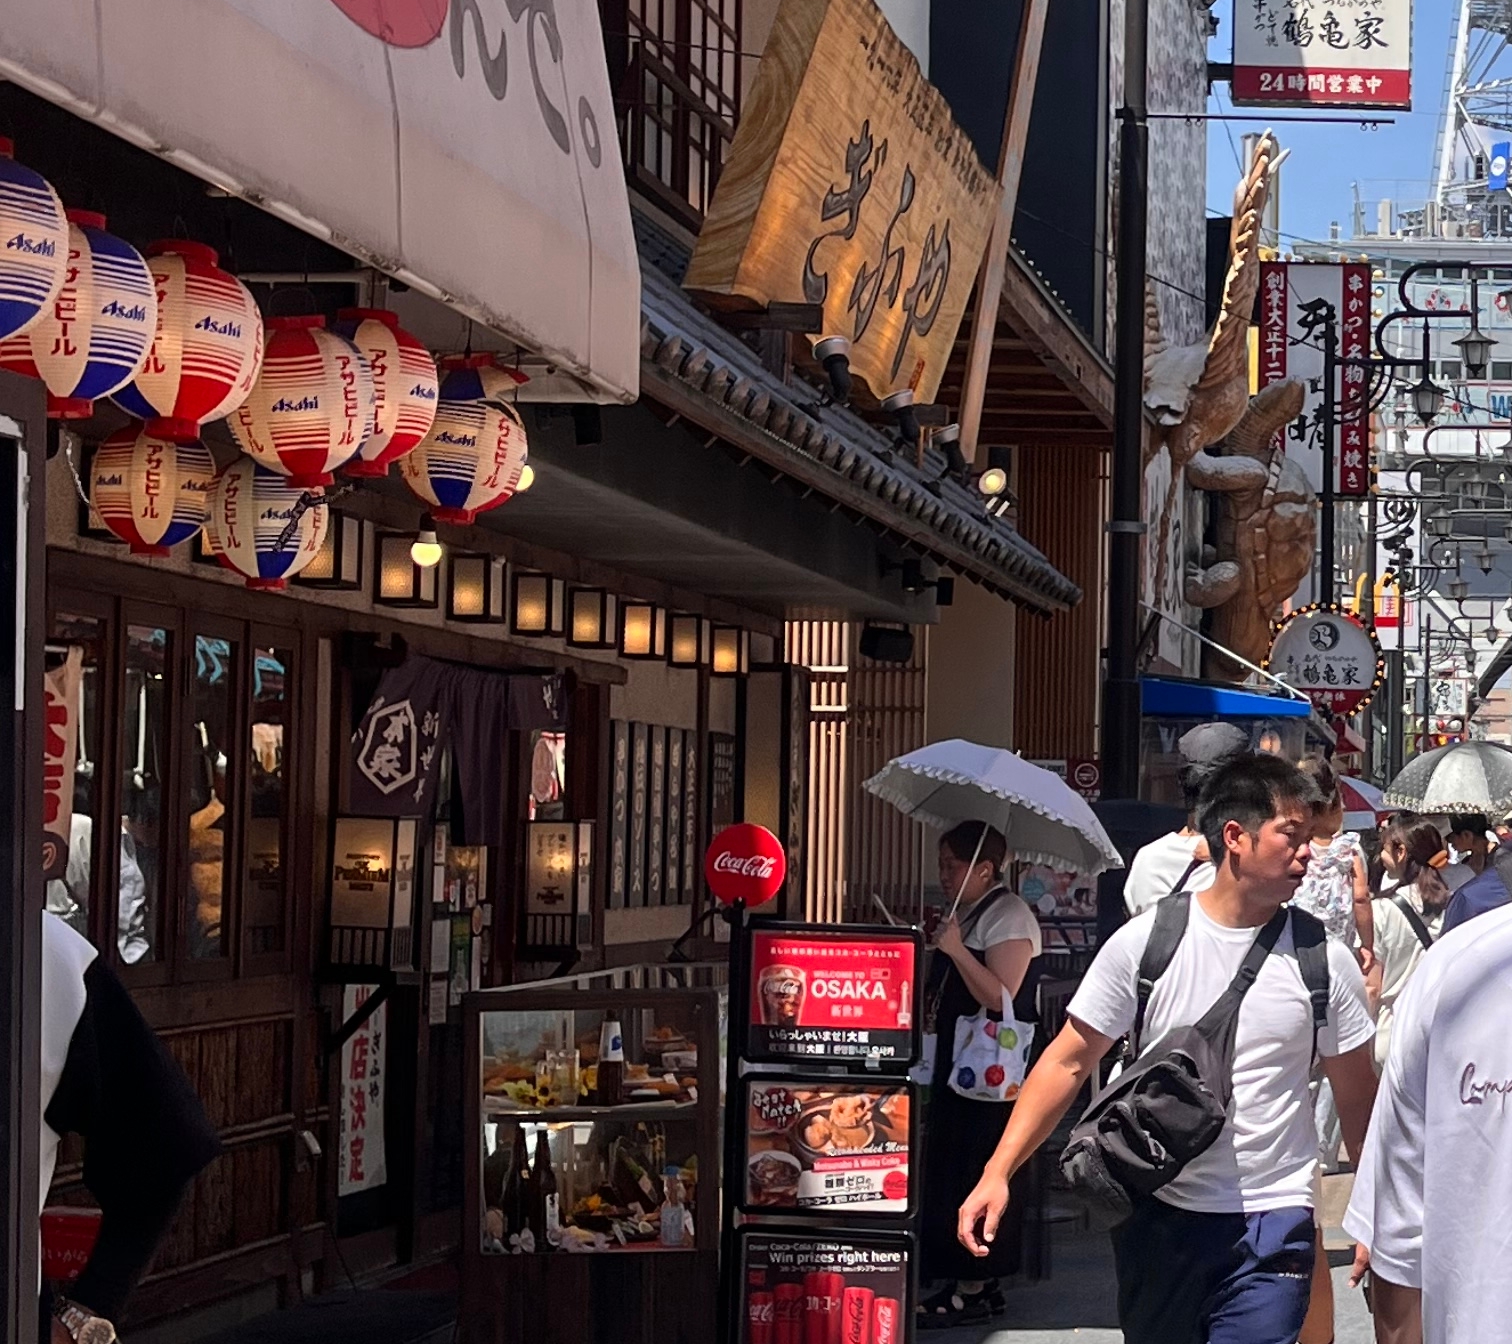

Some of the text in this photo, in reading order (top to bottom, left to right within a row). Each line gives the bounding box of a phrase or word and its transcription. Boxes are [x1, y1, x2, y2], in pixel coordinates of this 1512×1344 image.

[1282, 12, 1390, 50] 鶴亀家
[1259, 72, 1383, 96] 24時間営業中
[6, 232, 56, 258] Asahi
[101, 299, 147, 323] Asahi
[194, 316, 242, 340] Asahi
[271, 395, 319, 413] Asahi
[335, 355, 359, 446] アサヒビール
[434, 430, 477, 448] Asahi
[96, 474, 122, 487] sahi
[141, 444, 163, 520] アサヒビール
[225, 473, 242, 549] アサヒビール
[813, 970, 850, 979] WELCOME
[811, 979, 887, 1000] OSAKA
[769, 1252, 794, 1263] Win
[796, 1252, 834, 1265] prizes
[837, 1251, 868, 1266] right
[871, 1251, 900, 1263] here
